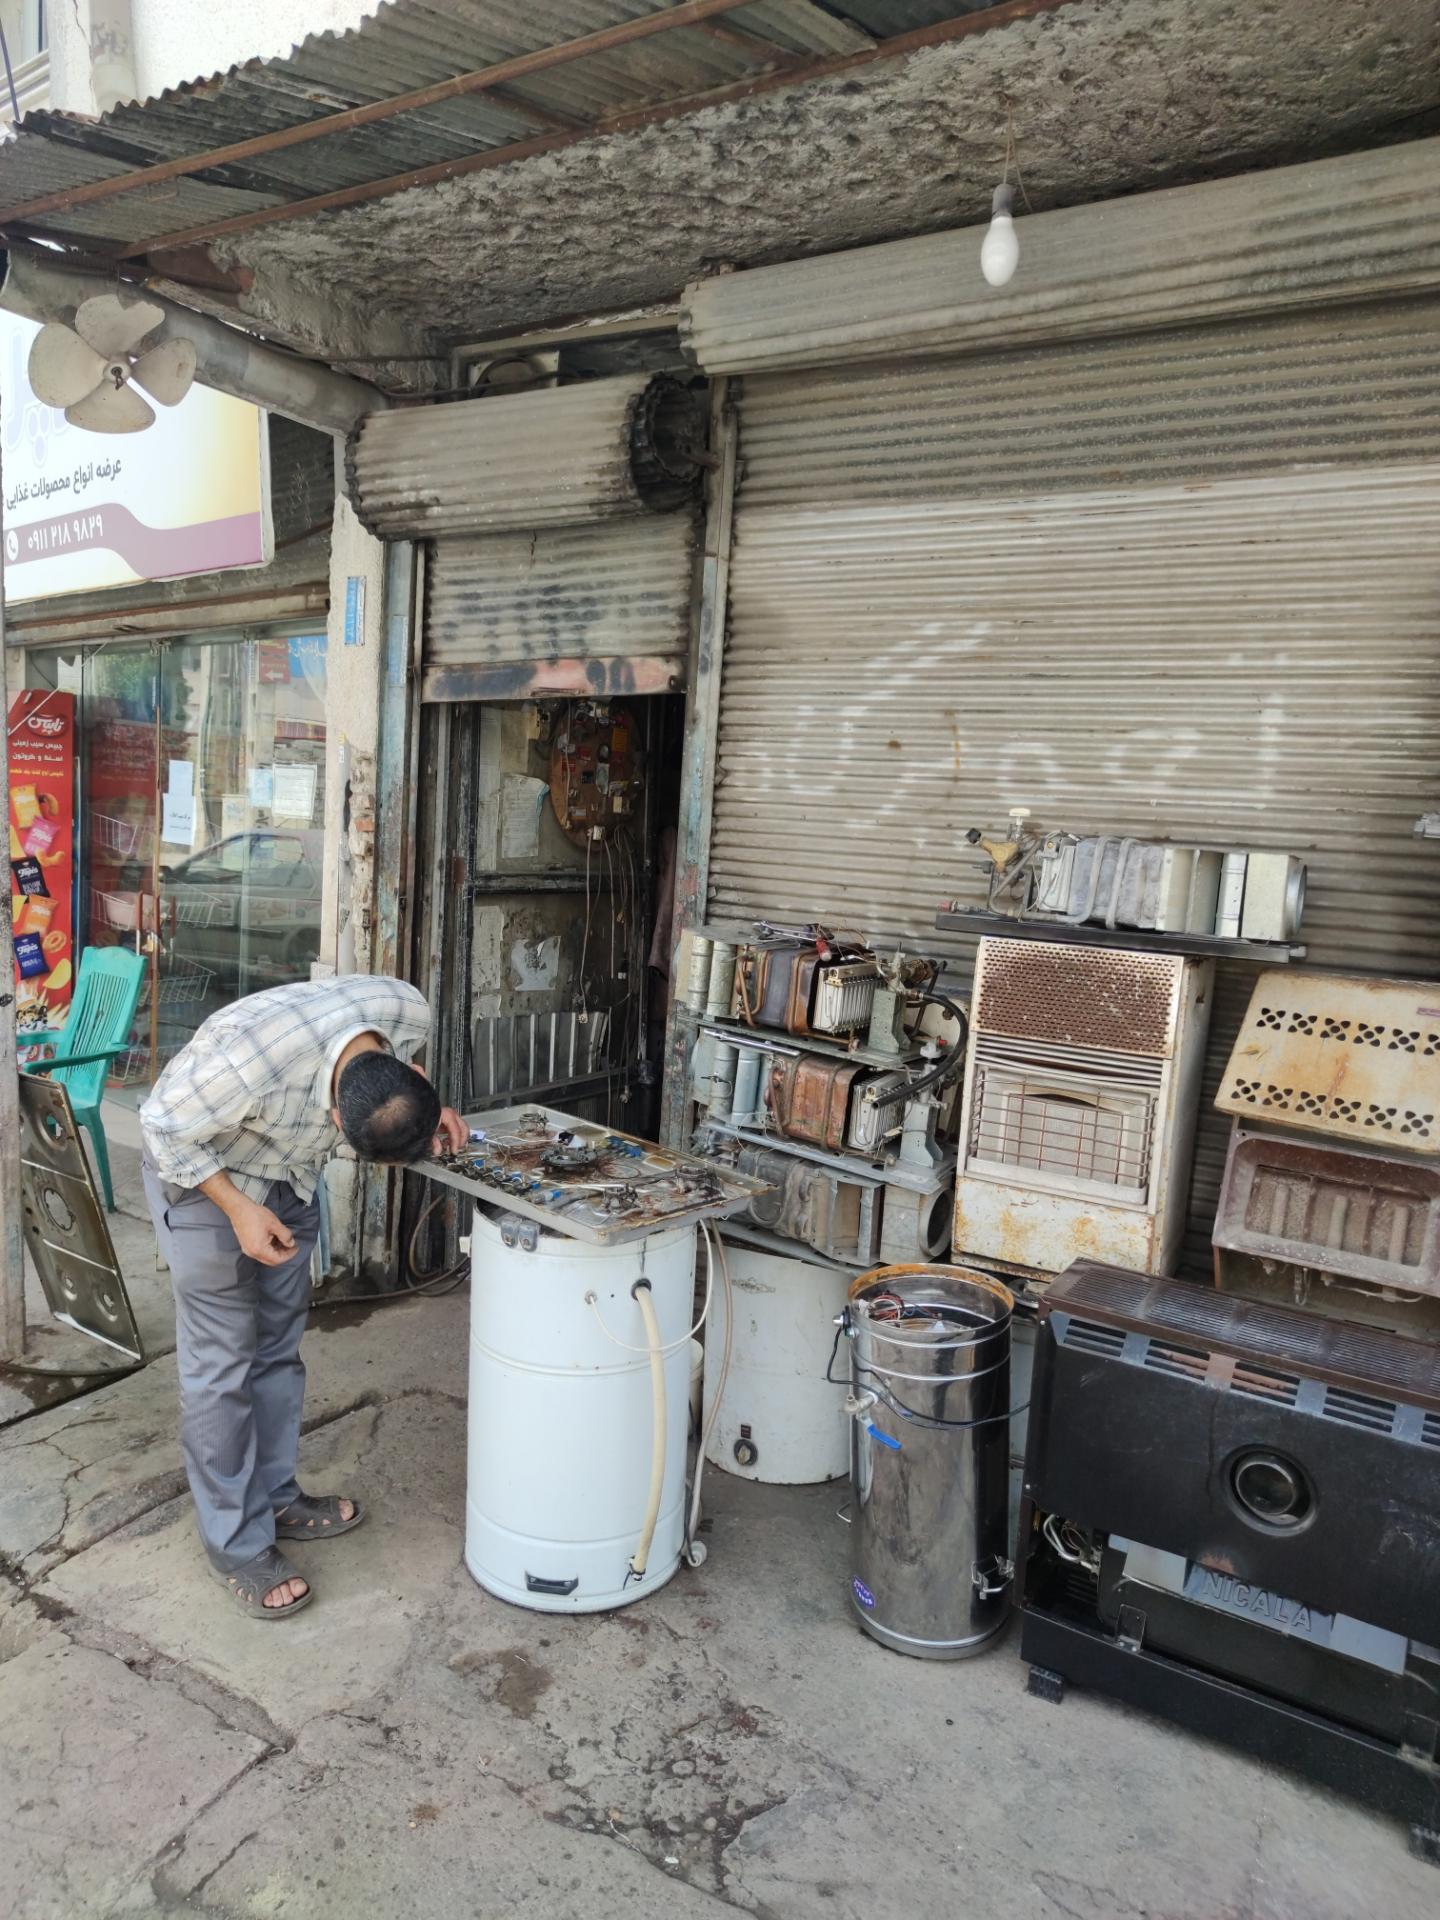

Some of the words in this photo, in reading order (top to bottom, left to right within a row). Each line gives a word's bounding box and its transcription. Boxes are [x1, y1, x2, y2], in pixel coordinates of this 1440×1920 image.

[73, 462, 94, 495] انواع
[96, 458, 122, 481] عرضه
[6, 482, 29, 511] غذایی
[30, 477, 71, 500] محصولات
[27, 528, 49, 551] ۰۹۱۱
[50, 522, 72, 547] ۲۱۸
[73, 513, 104, 543] ۹۸۲۹
[1203, 1569, 1313, 1633] NICALA
